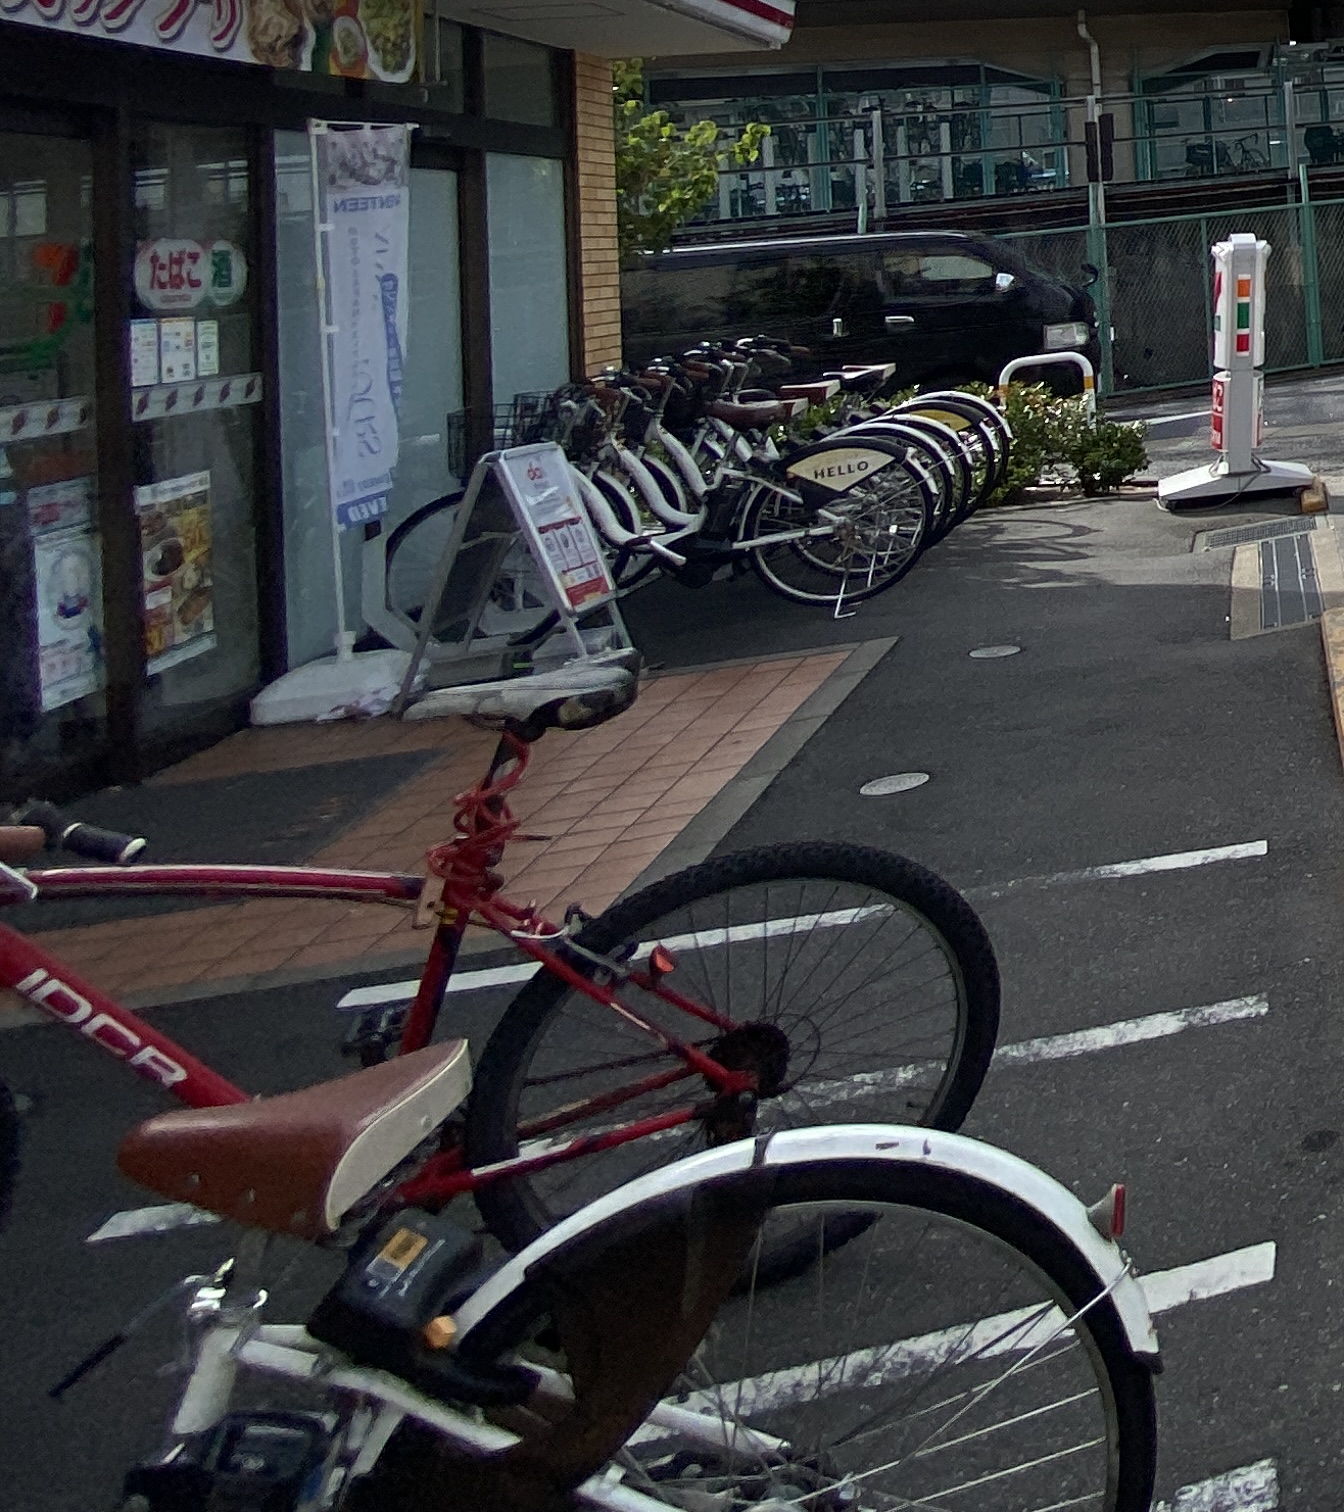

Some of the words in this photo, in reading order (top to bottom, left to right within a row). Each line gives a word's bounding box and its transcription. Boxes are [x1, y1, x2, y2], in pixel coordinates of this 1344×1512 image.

[149, 249, 202, 290] たばこ
[813, 461, 869, 479] HELLO
